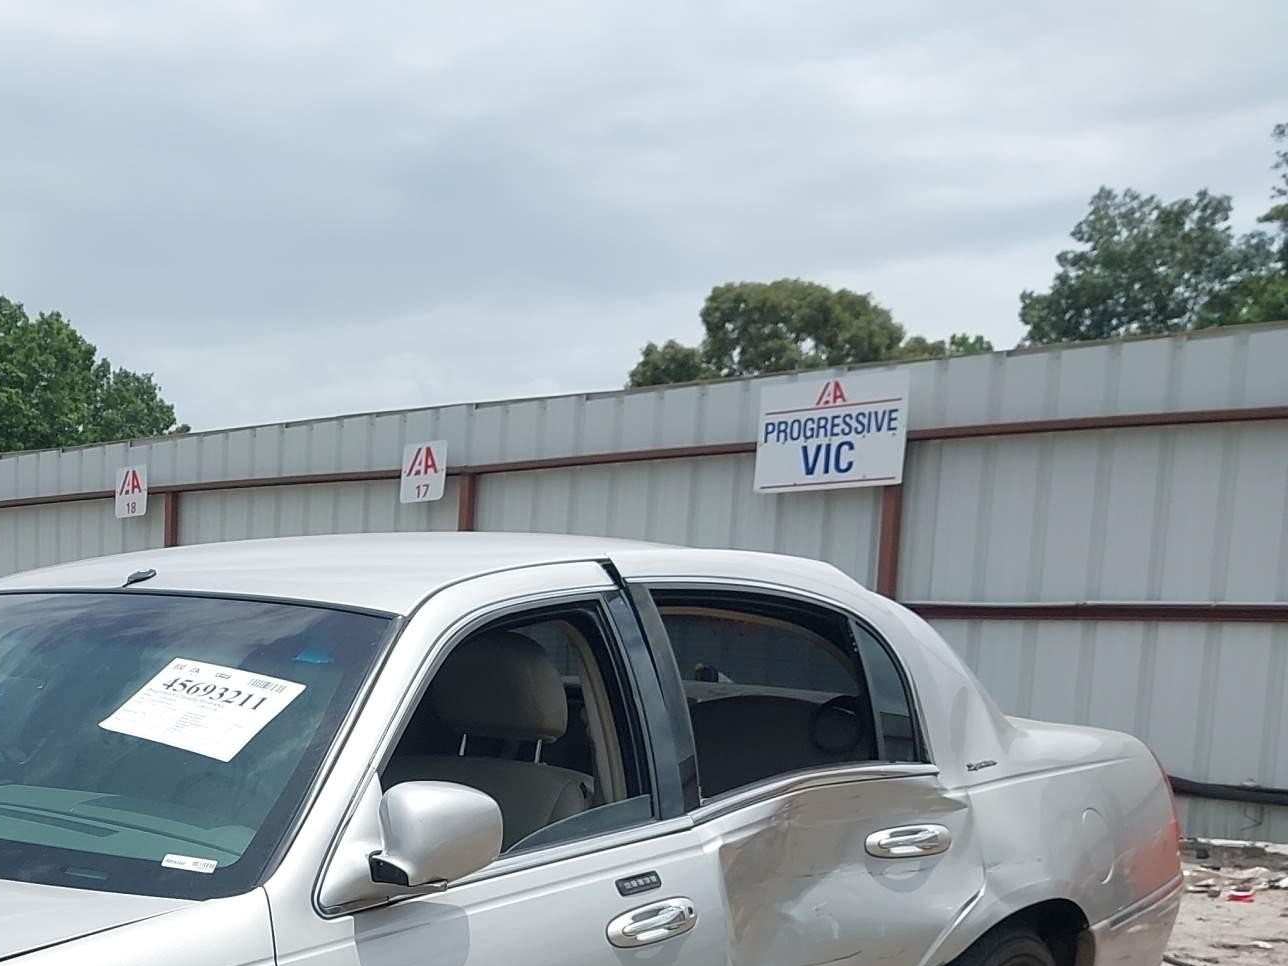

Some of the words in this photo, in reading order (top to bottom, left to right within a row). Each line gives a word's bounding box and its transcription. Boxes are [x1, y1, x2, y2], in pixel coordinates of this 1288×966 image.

[763, 408, 899, 443] PROGRESSIVE
[801, 441, 855, 476] VIC
[126, 502, 137, 515] 18
[415, 484, 430, 499] 17
[162, 677, 268, 711] 45693211
